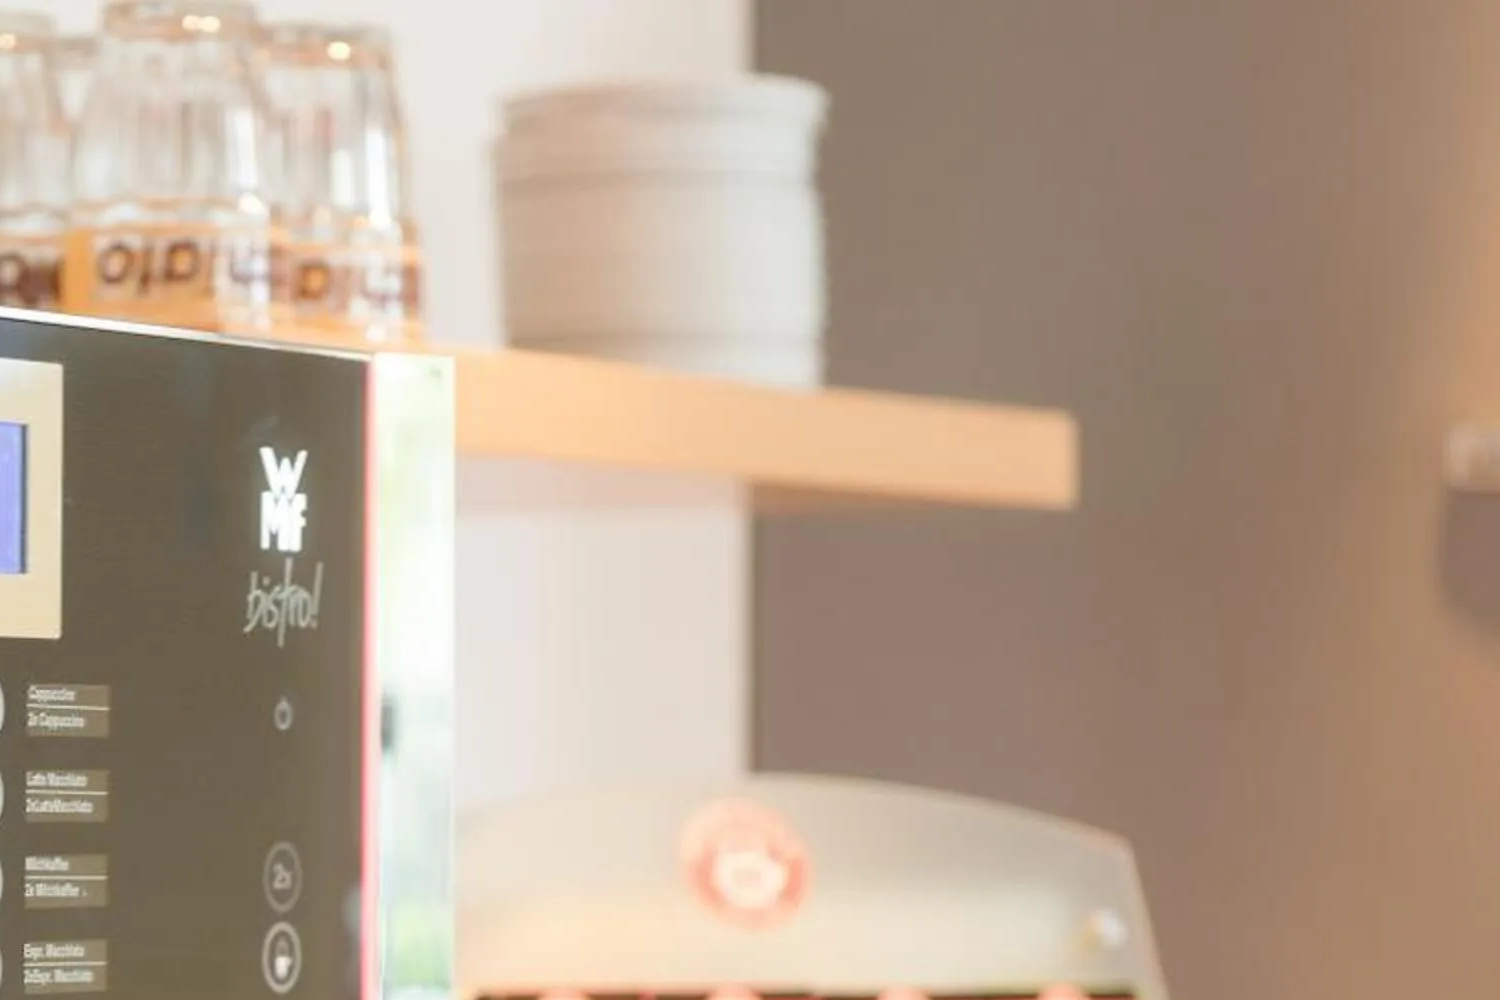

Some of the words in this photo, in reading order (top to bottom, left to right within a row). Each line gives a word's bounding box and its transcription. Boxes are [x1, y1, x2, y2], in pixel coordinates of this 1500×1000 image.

[259, 446, 308, 553] WMF
[243, 556, 325, 648] bistro!
[272, 861, 291, 887] 2x
